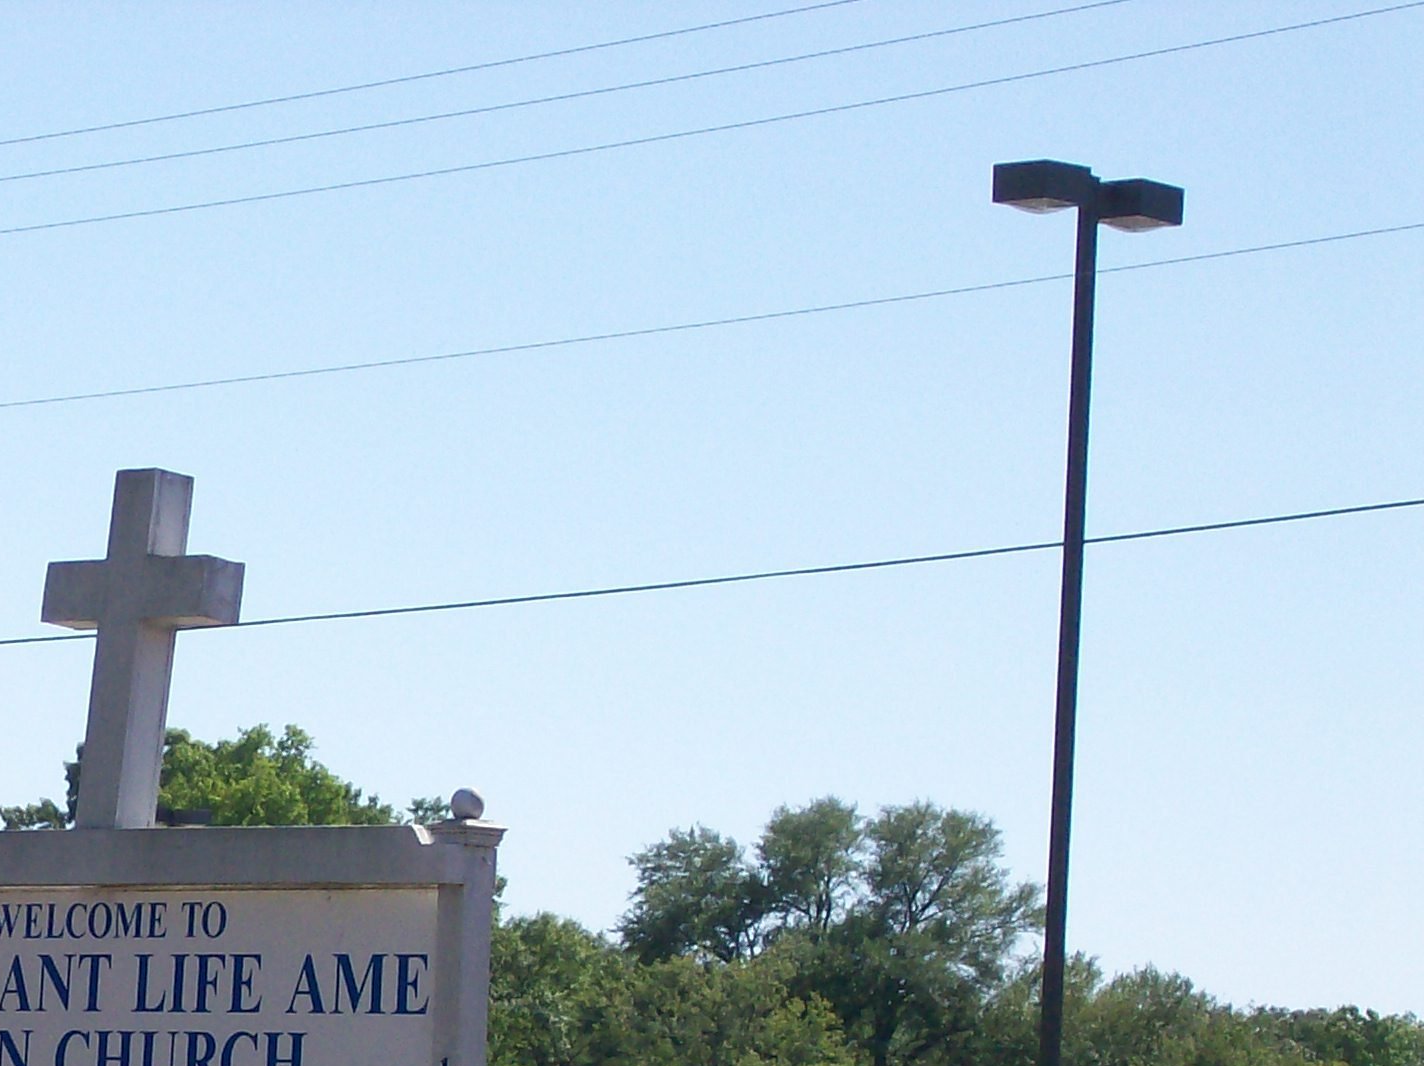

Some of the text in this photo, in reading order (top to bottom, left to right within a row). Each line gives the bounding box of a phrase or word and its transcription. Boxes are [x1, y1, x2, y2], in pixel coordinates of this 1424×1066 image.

[181, 901, 228, 938] TO
[132, 953, 262, 1014] LIFE
[288, 953, 430, 1016] AME
